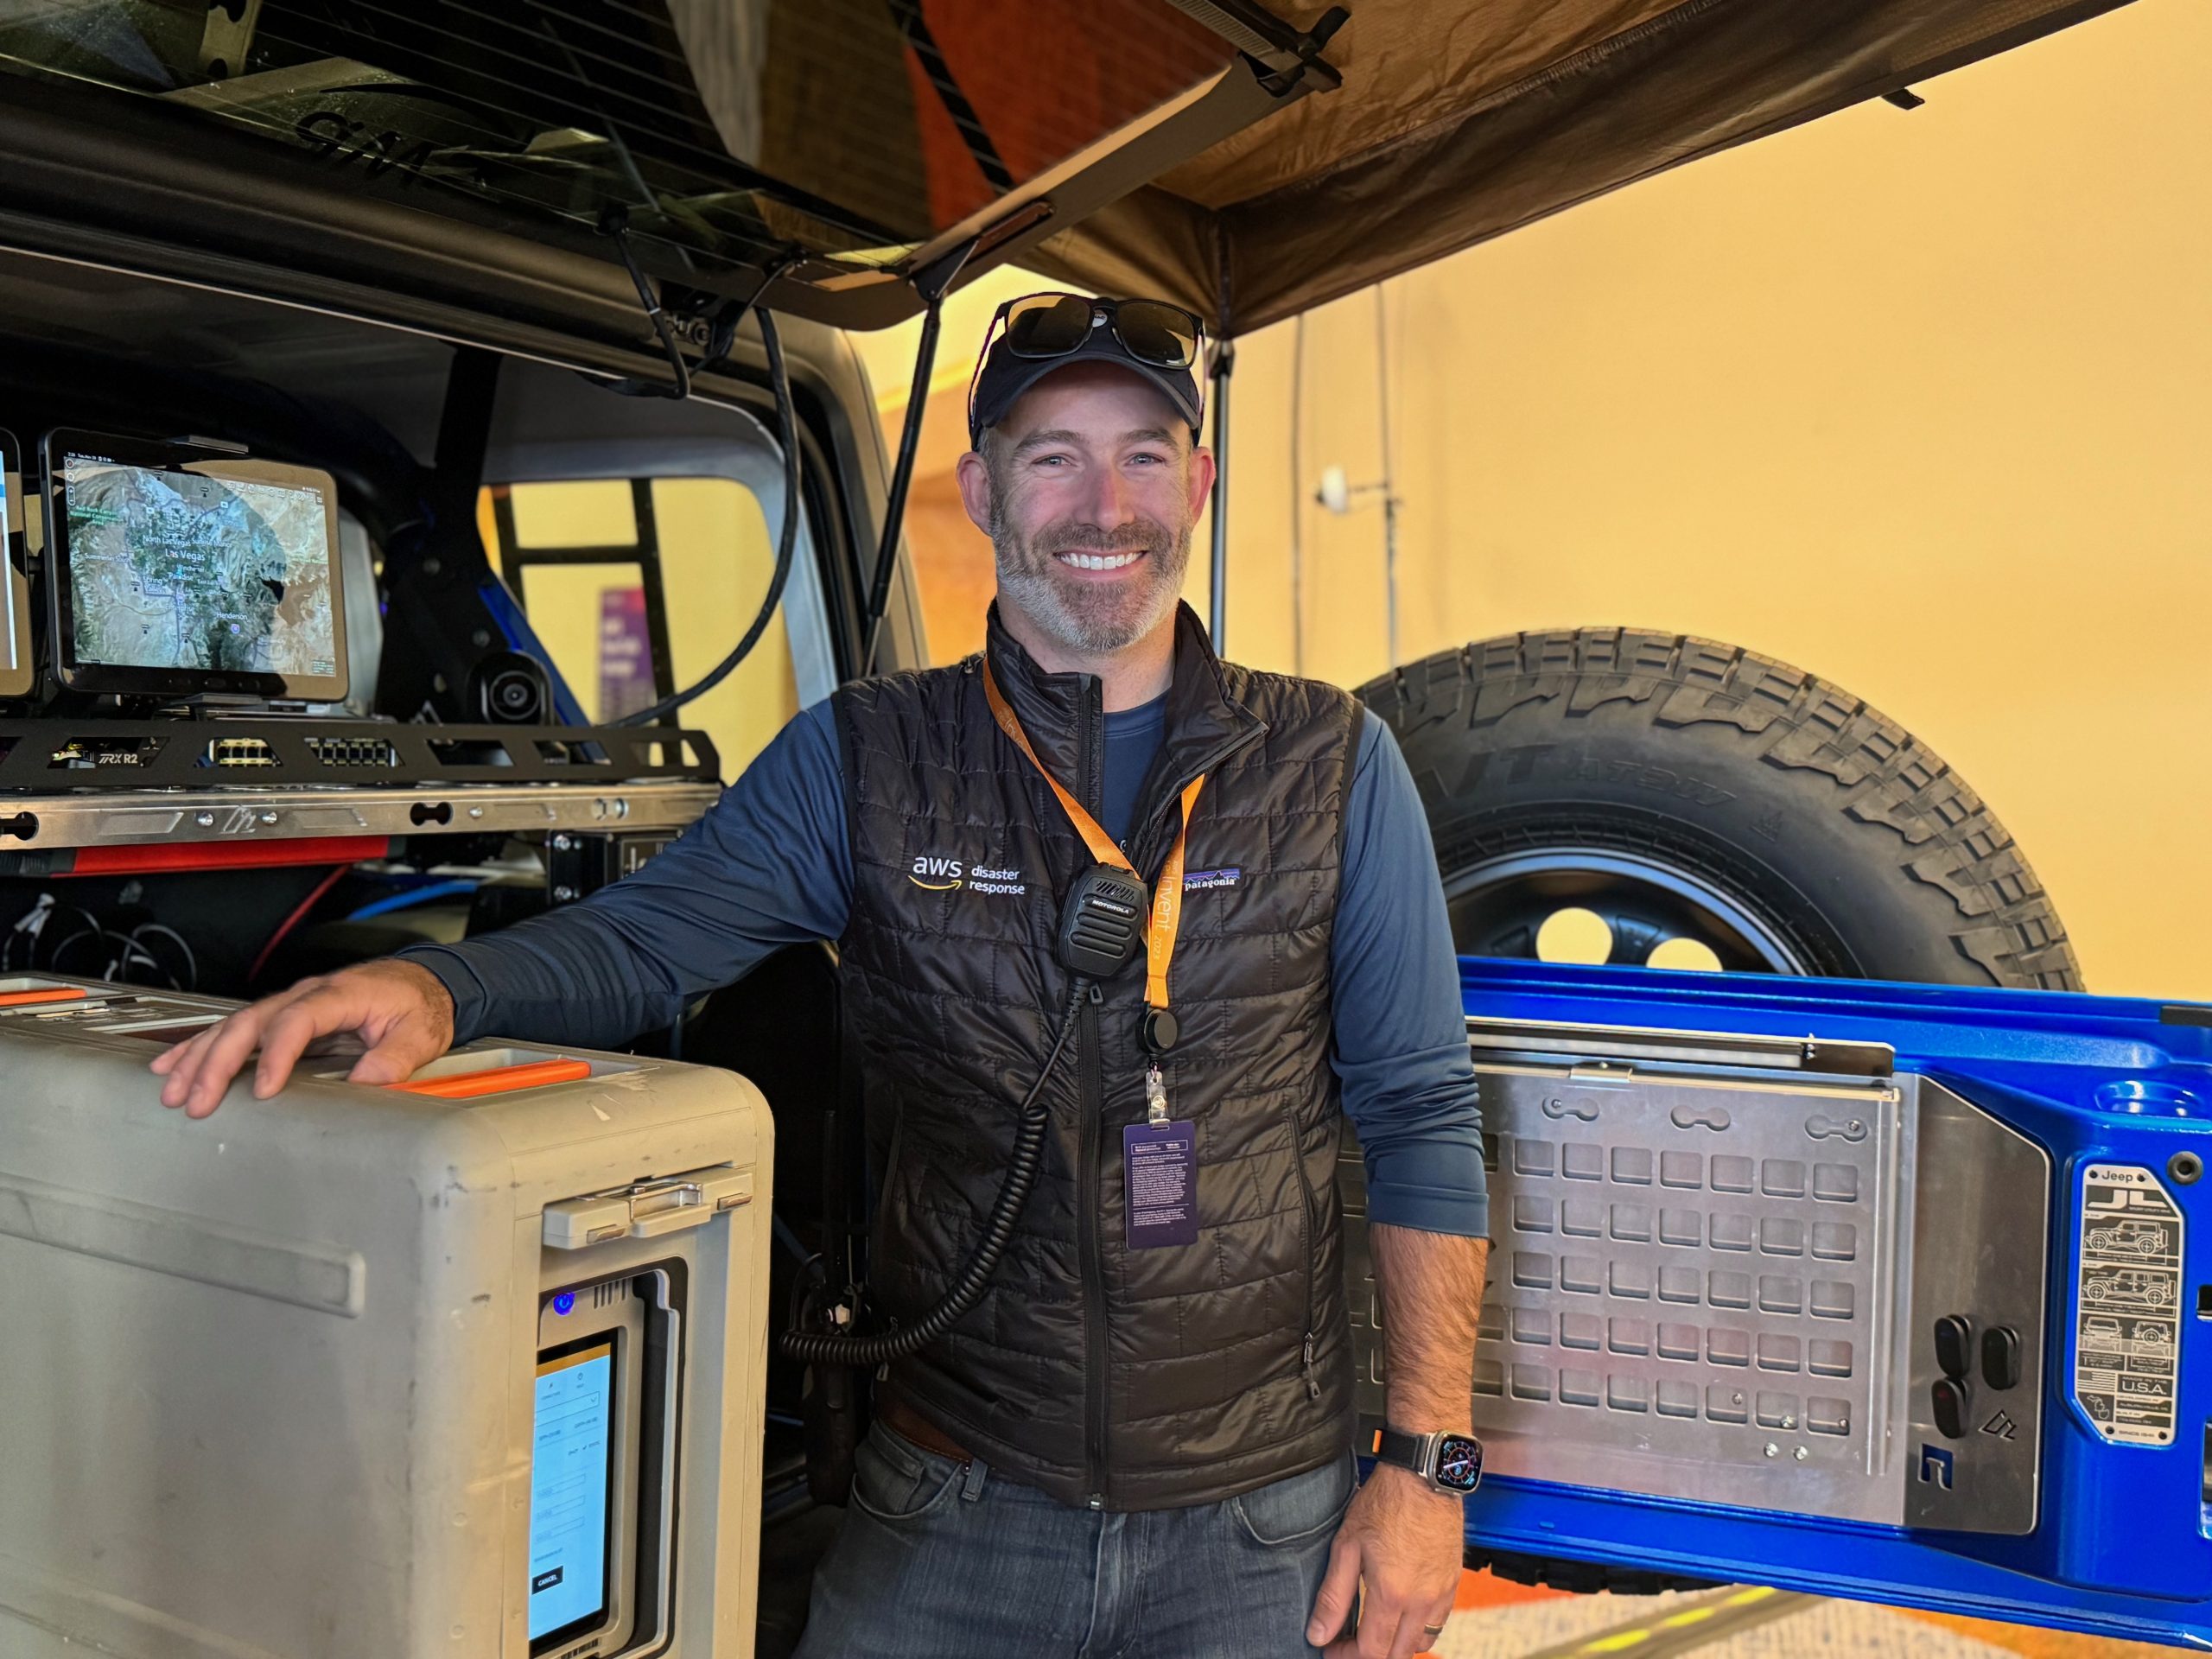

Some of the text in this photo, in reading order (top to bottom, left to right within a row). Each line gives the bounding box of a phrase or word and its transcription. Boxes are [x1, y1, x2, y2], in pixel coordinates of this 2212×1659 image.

[165, 549, 206, 563] Las Vegas
[216, 611, 248, 620] Henderson
[124, 753, 138, 764] R2
[912, 856, 963, 878] aws
[971, 865, 1020, 880] disaster
[969, 880, 1026, 895] response
[1185, 877, 1236, 892] patagonia
[1091, 899, 1129, 915] MOTOROLA
[1153, 936, 1162, 960] 2023
[2101, 1170, 2133, 1183] Jeep
[2088, 1189, 2168, 1209] JL
[2122, 1380, 2167, 1395] U.S.A.
